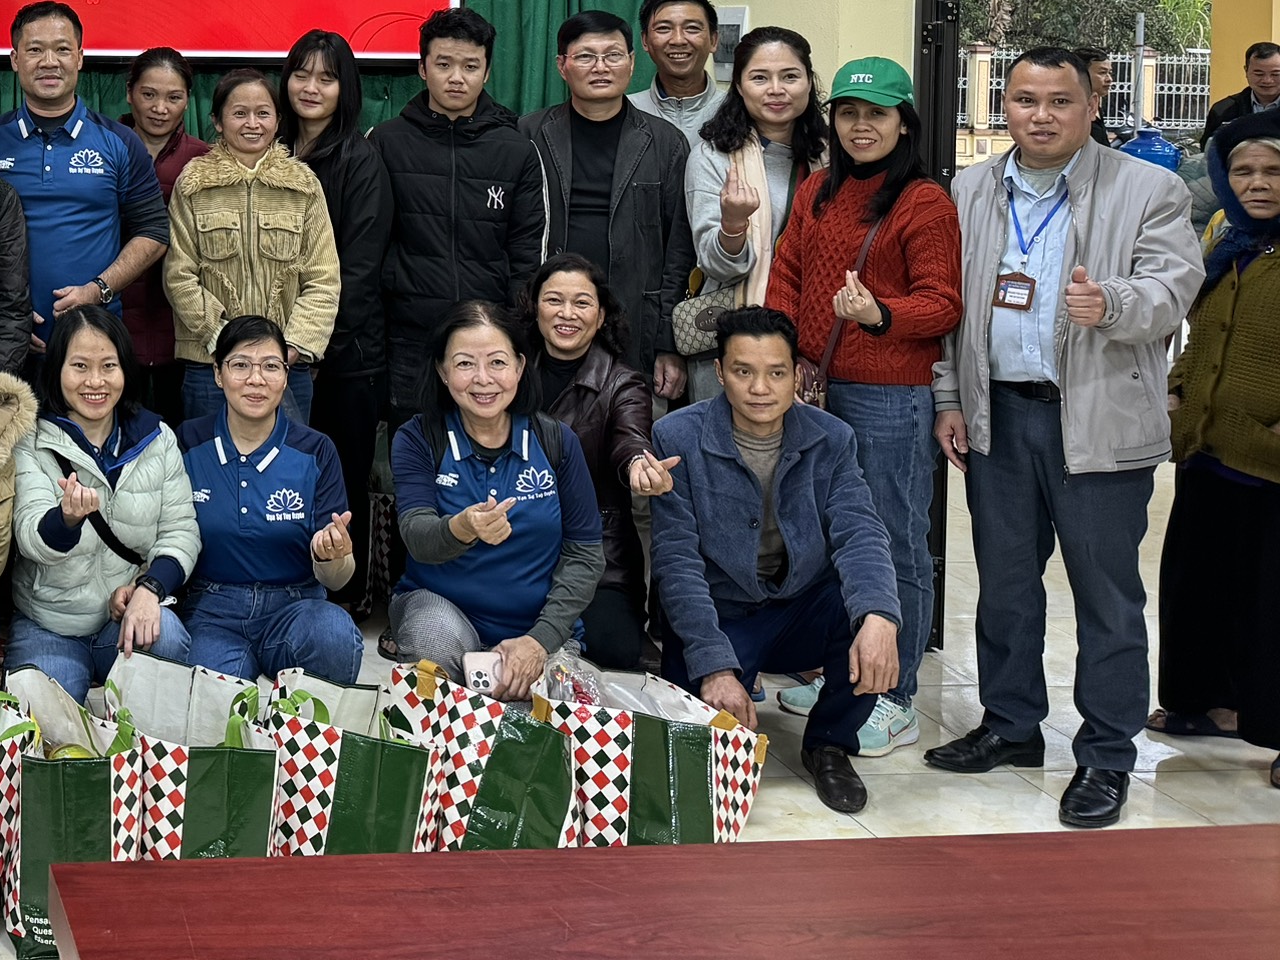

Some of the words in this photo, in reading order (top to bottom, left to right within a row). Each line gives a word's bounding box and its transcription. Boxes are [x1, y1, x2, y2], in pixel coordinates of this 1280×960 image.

[849, 73, 874, 84] NYC
[486, 185, 505, 210] NY
[24, 915, 51, 925] Pensa
[32, 926, 52, 936] Ques
